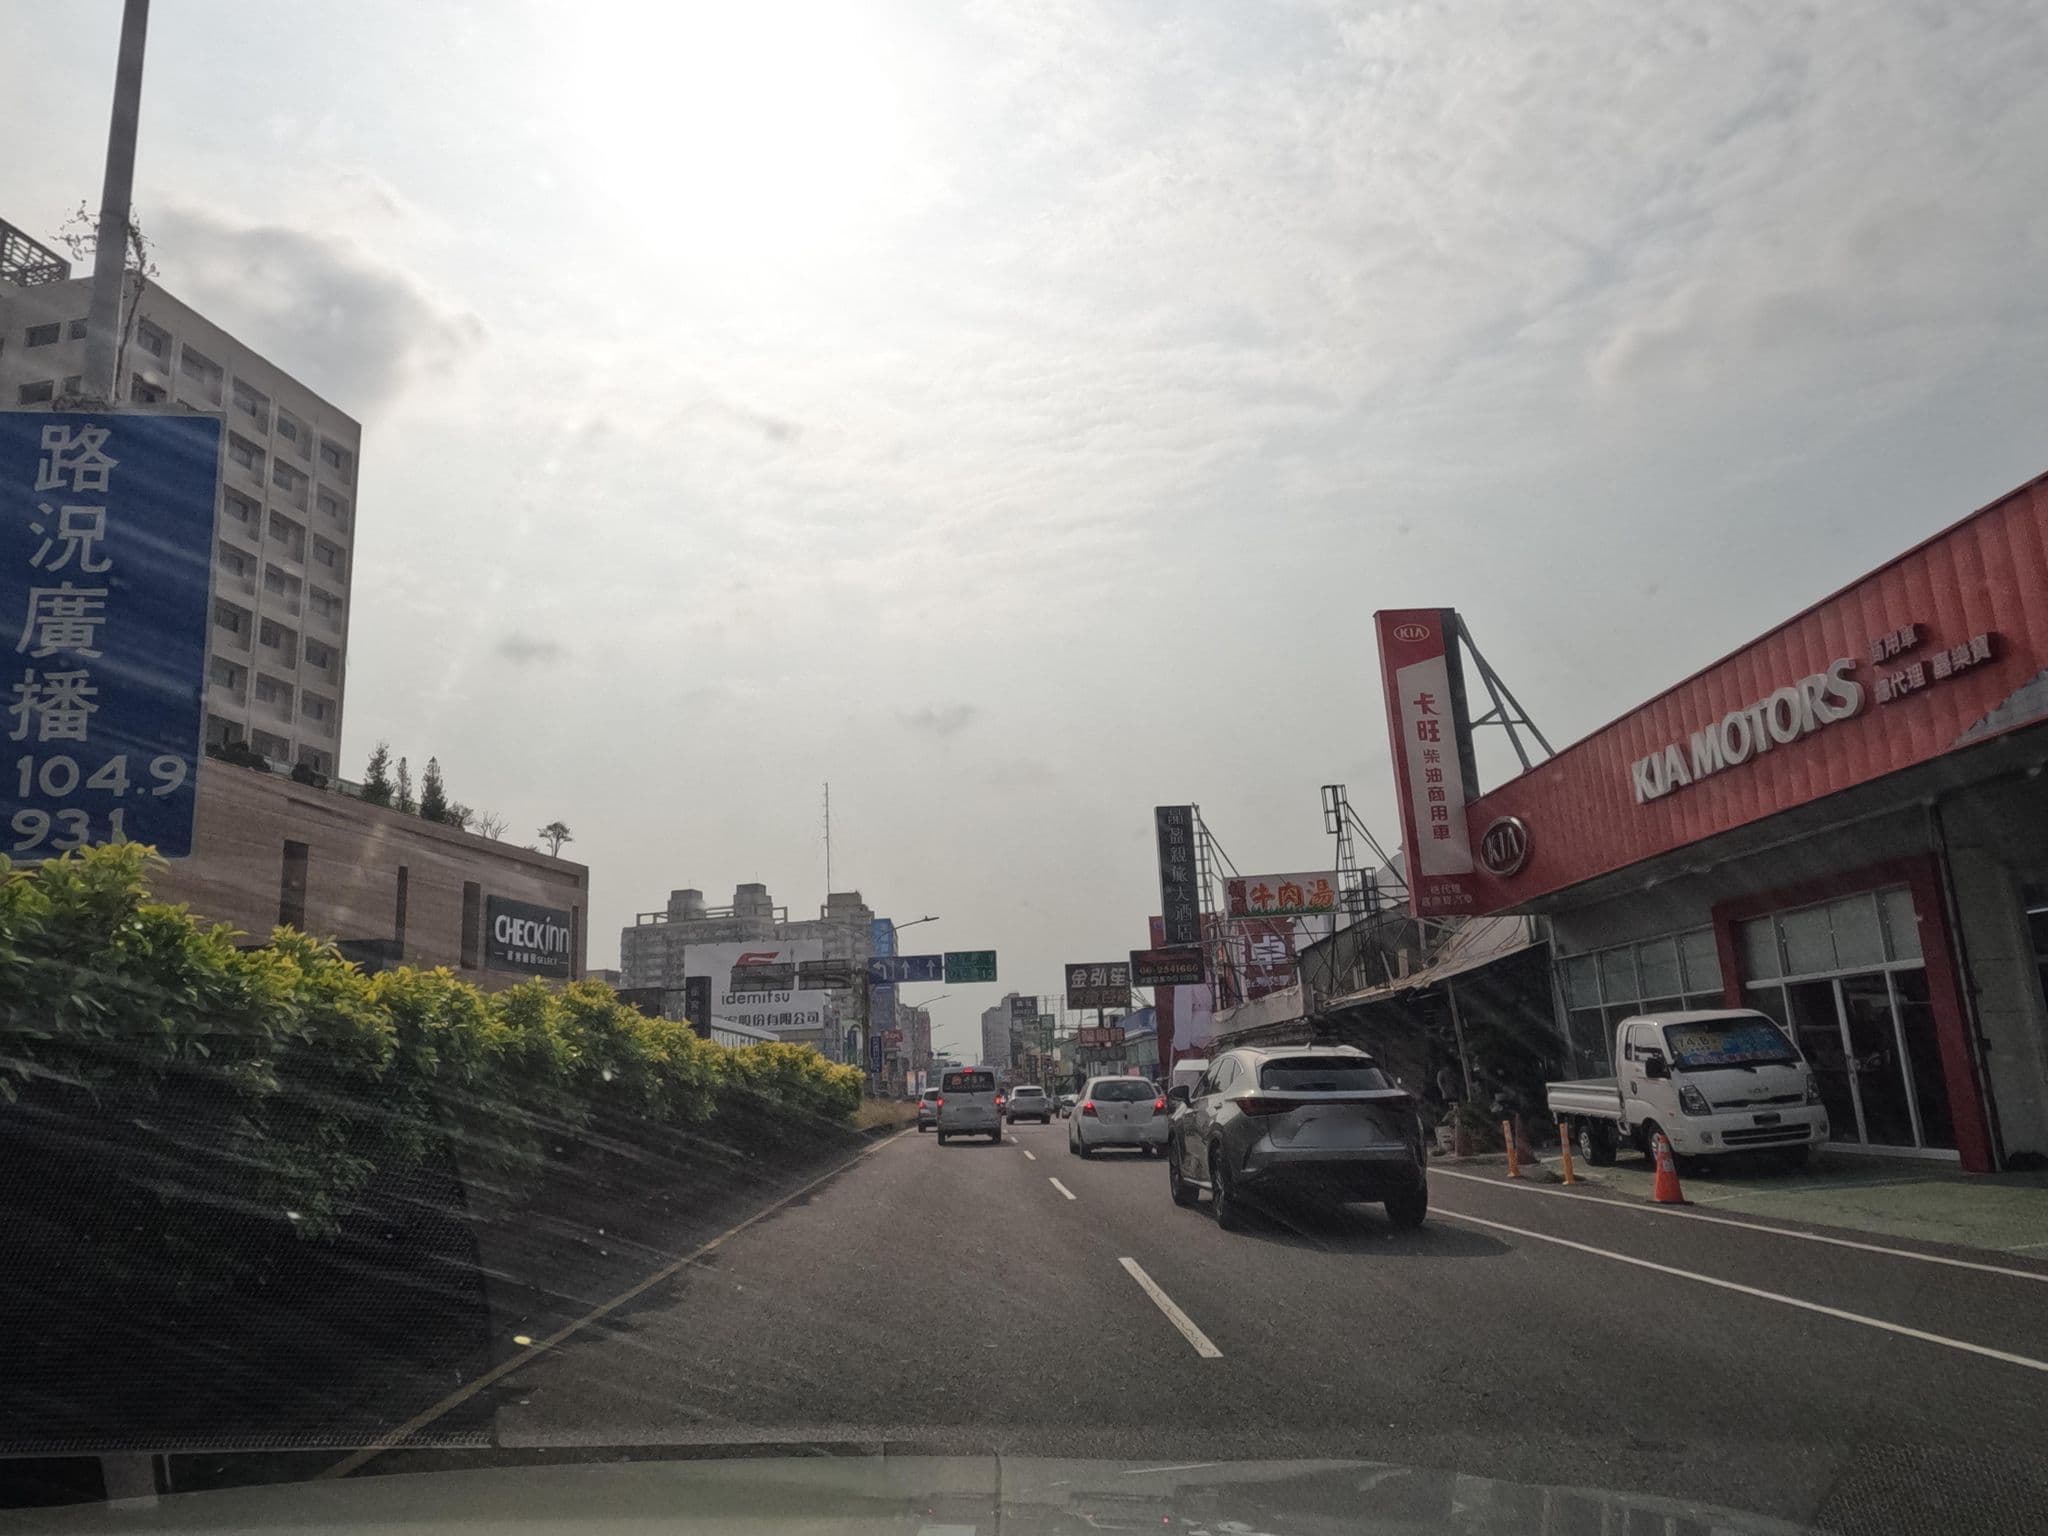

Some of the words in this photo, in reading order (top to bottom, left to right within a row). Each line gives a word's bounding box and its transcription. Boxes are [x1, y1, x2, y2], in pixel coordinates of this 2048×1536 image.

[9, 424, 120, 741] 路況廣播
[1399, 627, 1424, 638] KIA
[1631, 743, 1694, 804] KIA
[1690, 657, 1867, 779] MOTORS
[15, 754, 188, 798] 104.9
[1485, 827, 1519, 863] KIA
[1249, 879, 1335, 909] 牛肉湯
[1071, 967, 1127, 988] 金弘笙
[721, 991, 790, 1006] idemitsu
